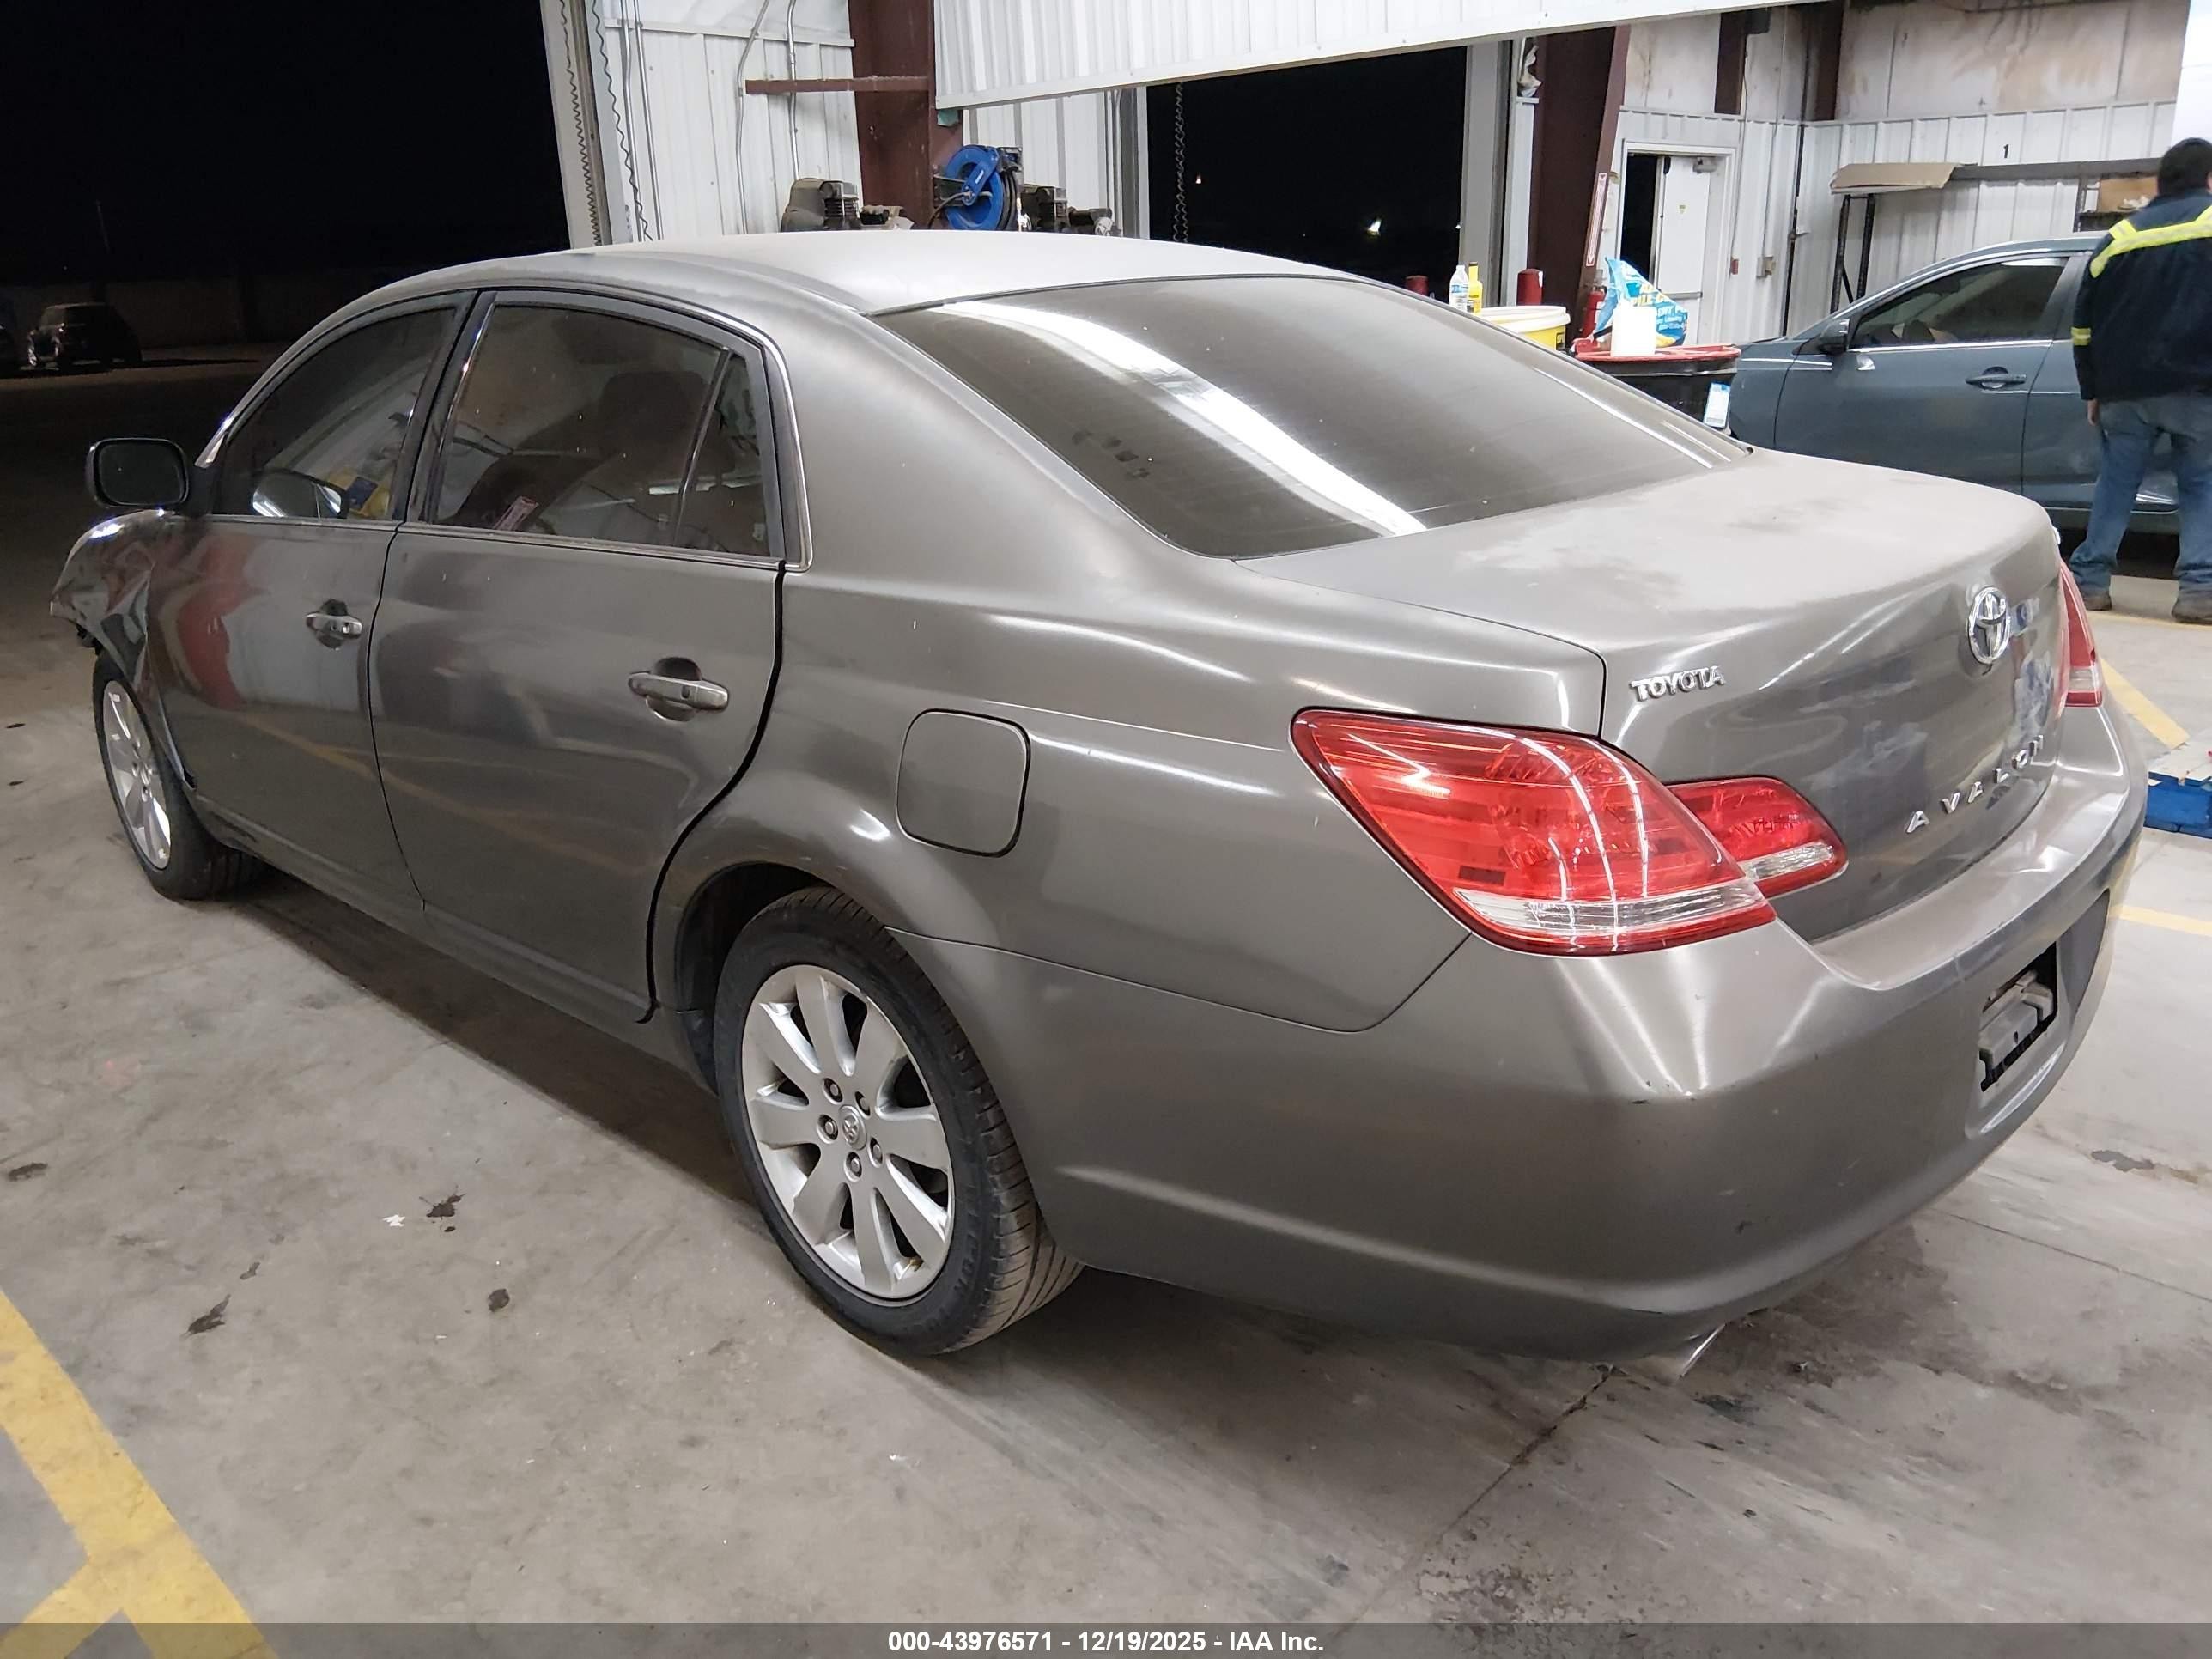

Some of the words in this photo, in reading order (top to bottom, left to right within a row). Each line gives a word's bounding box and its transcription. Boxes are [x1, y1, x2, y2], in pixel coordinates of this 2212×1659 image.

[2003, 143, 2009, 159] 1
[1630, 665, 1727, 702] TOYOTA
[1905, 734, 2044, 834] AVALON
